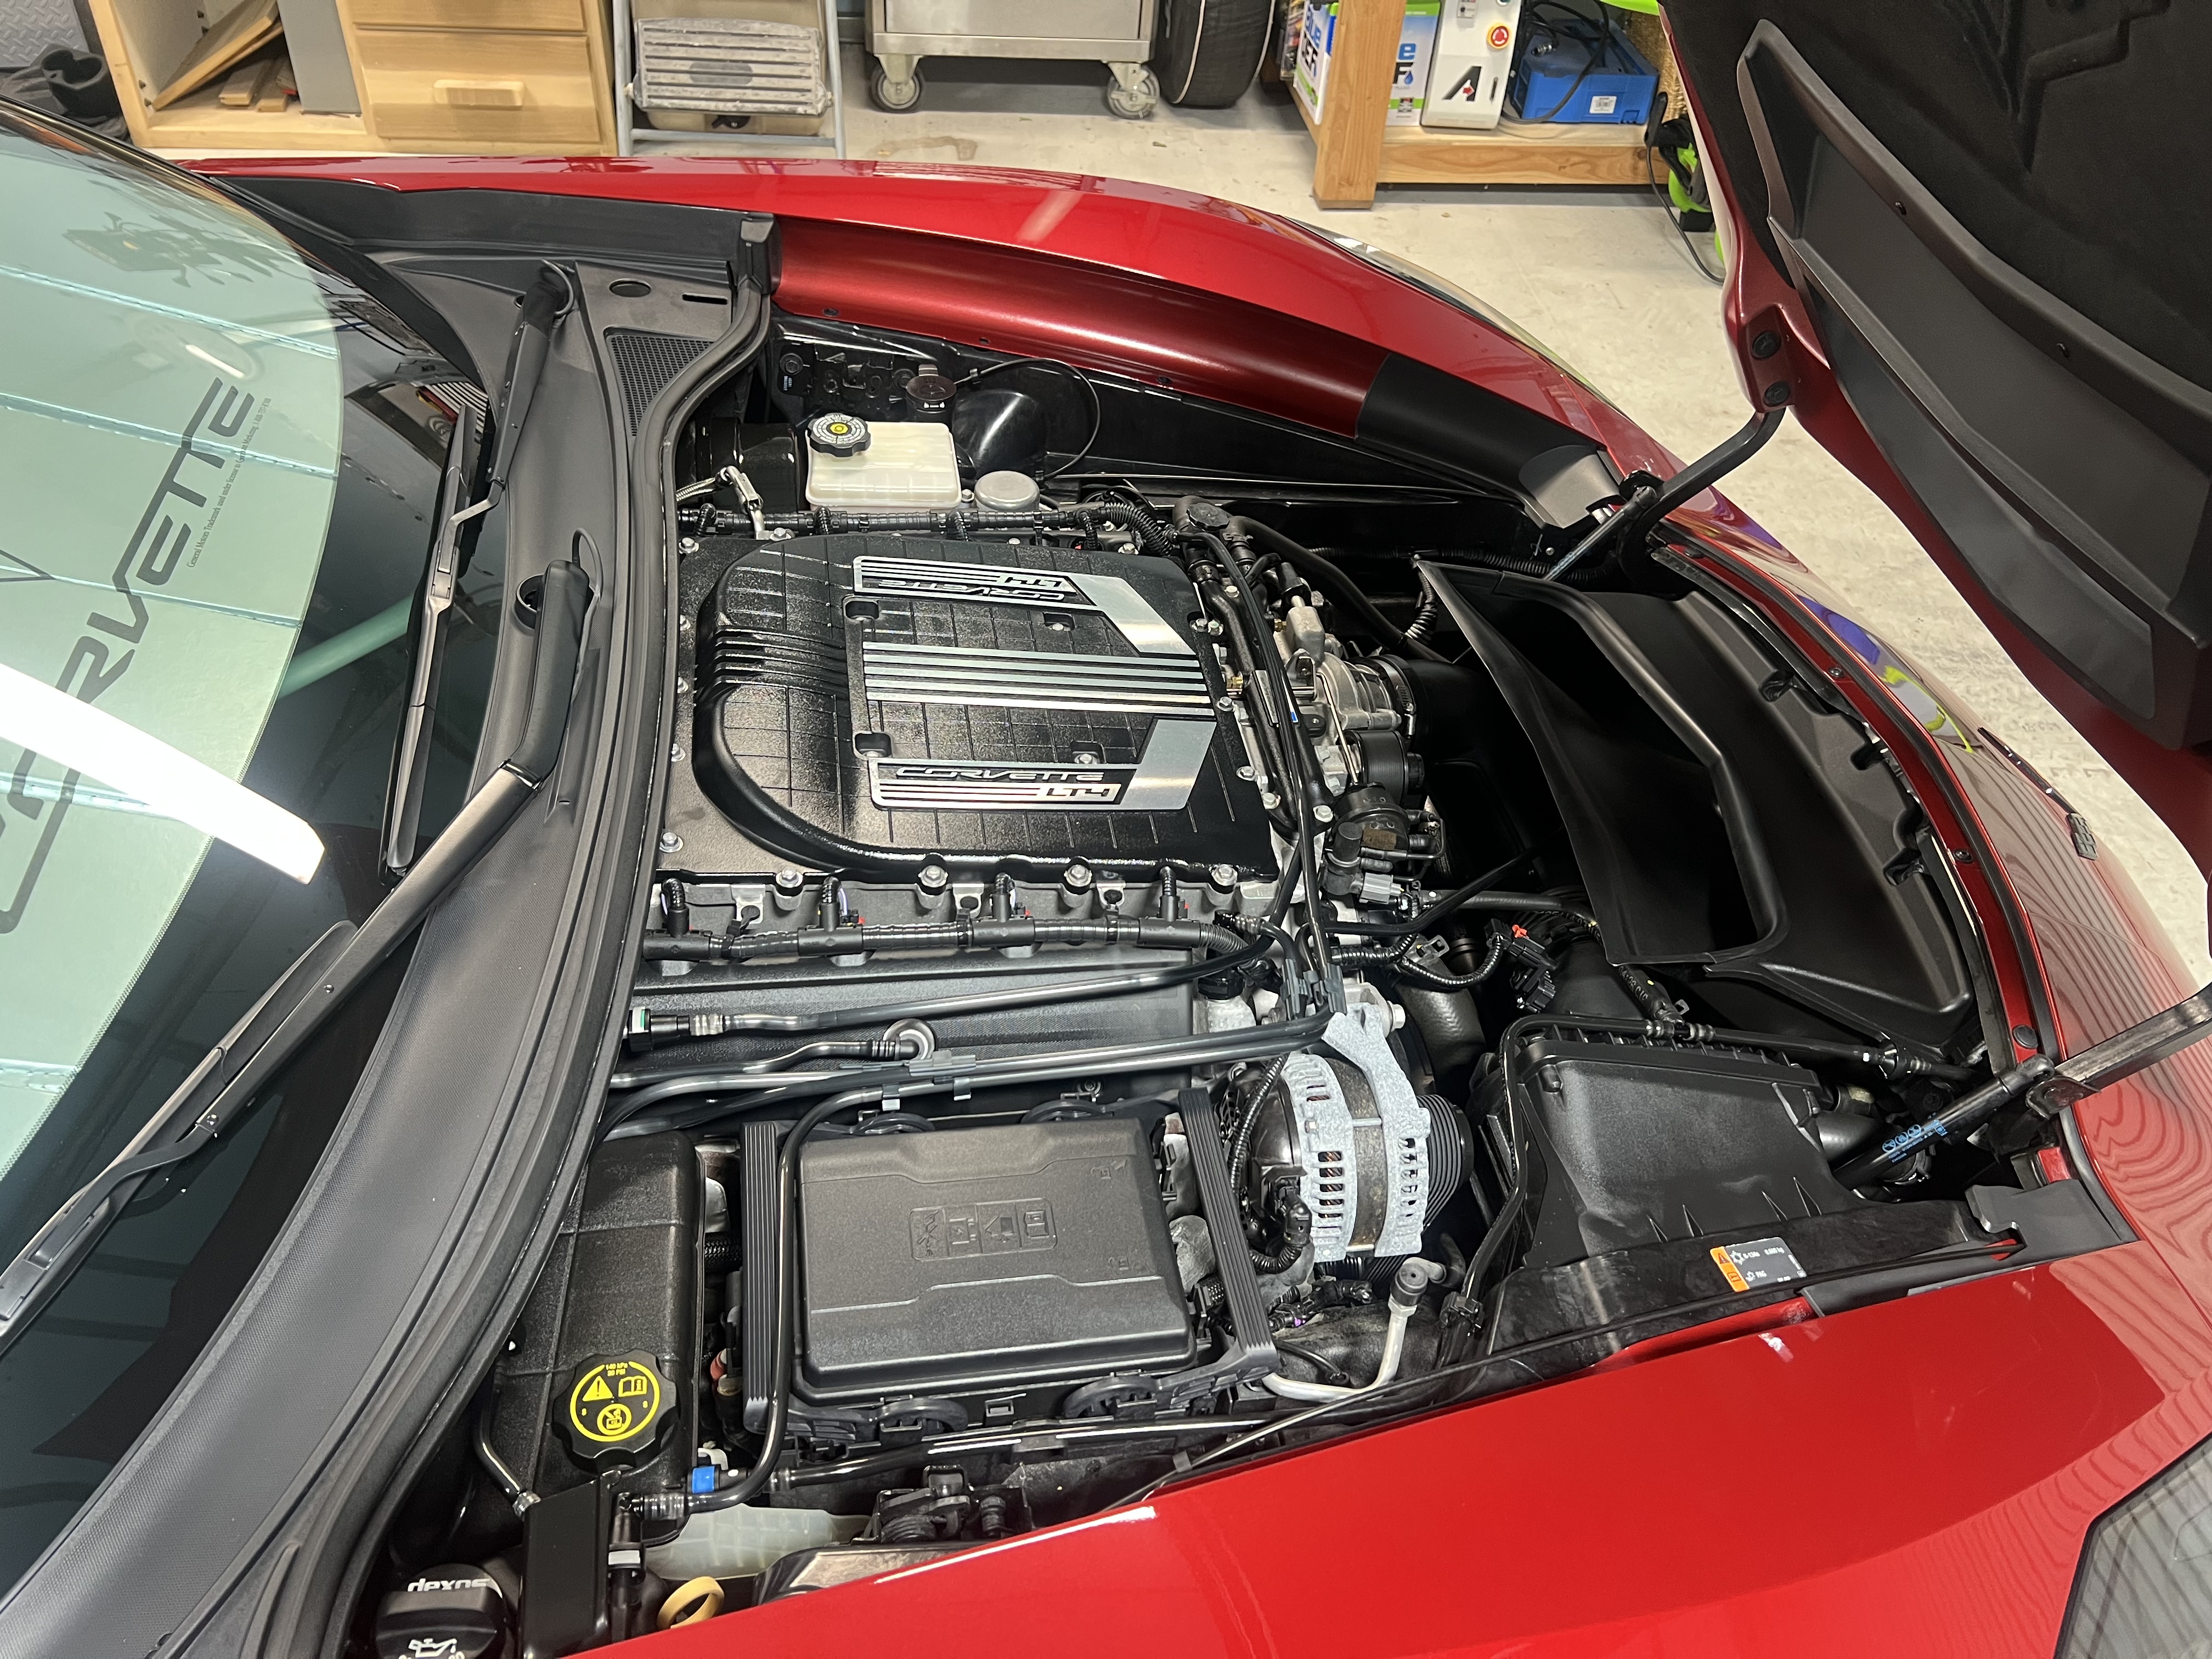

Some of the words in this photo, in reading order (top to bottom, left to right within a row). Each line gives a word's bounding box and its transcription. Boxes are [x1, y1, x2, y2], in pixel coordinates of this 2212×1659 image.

[187, 548, 202, 568] General
[195, 531, 210, 549] Motors
[203, 507, 221, 531] Trademark
[1004, 576, 1063, 587] LT4
[878, 579, 1065, 601] CORVETTE
[896, 766, 1104, 781] CORVETTE
[1047, 787, 1111, 797] LT4
